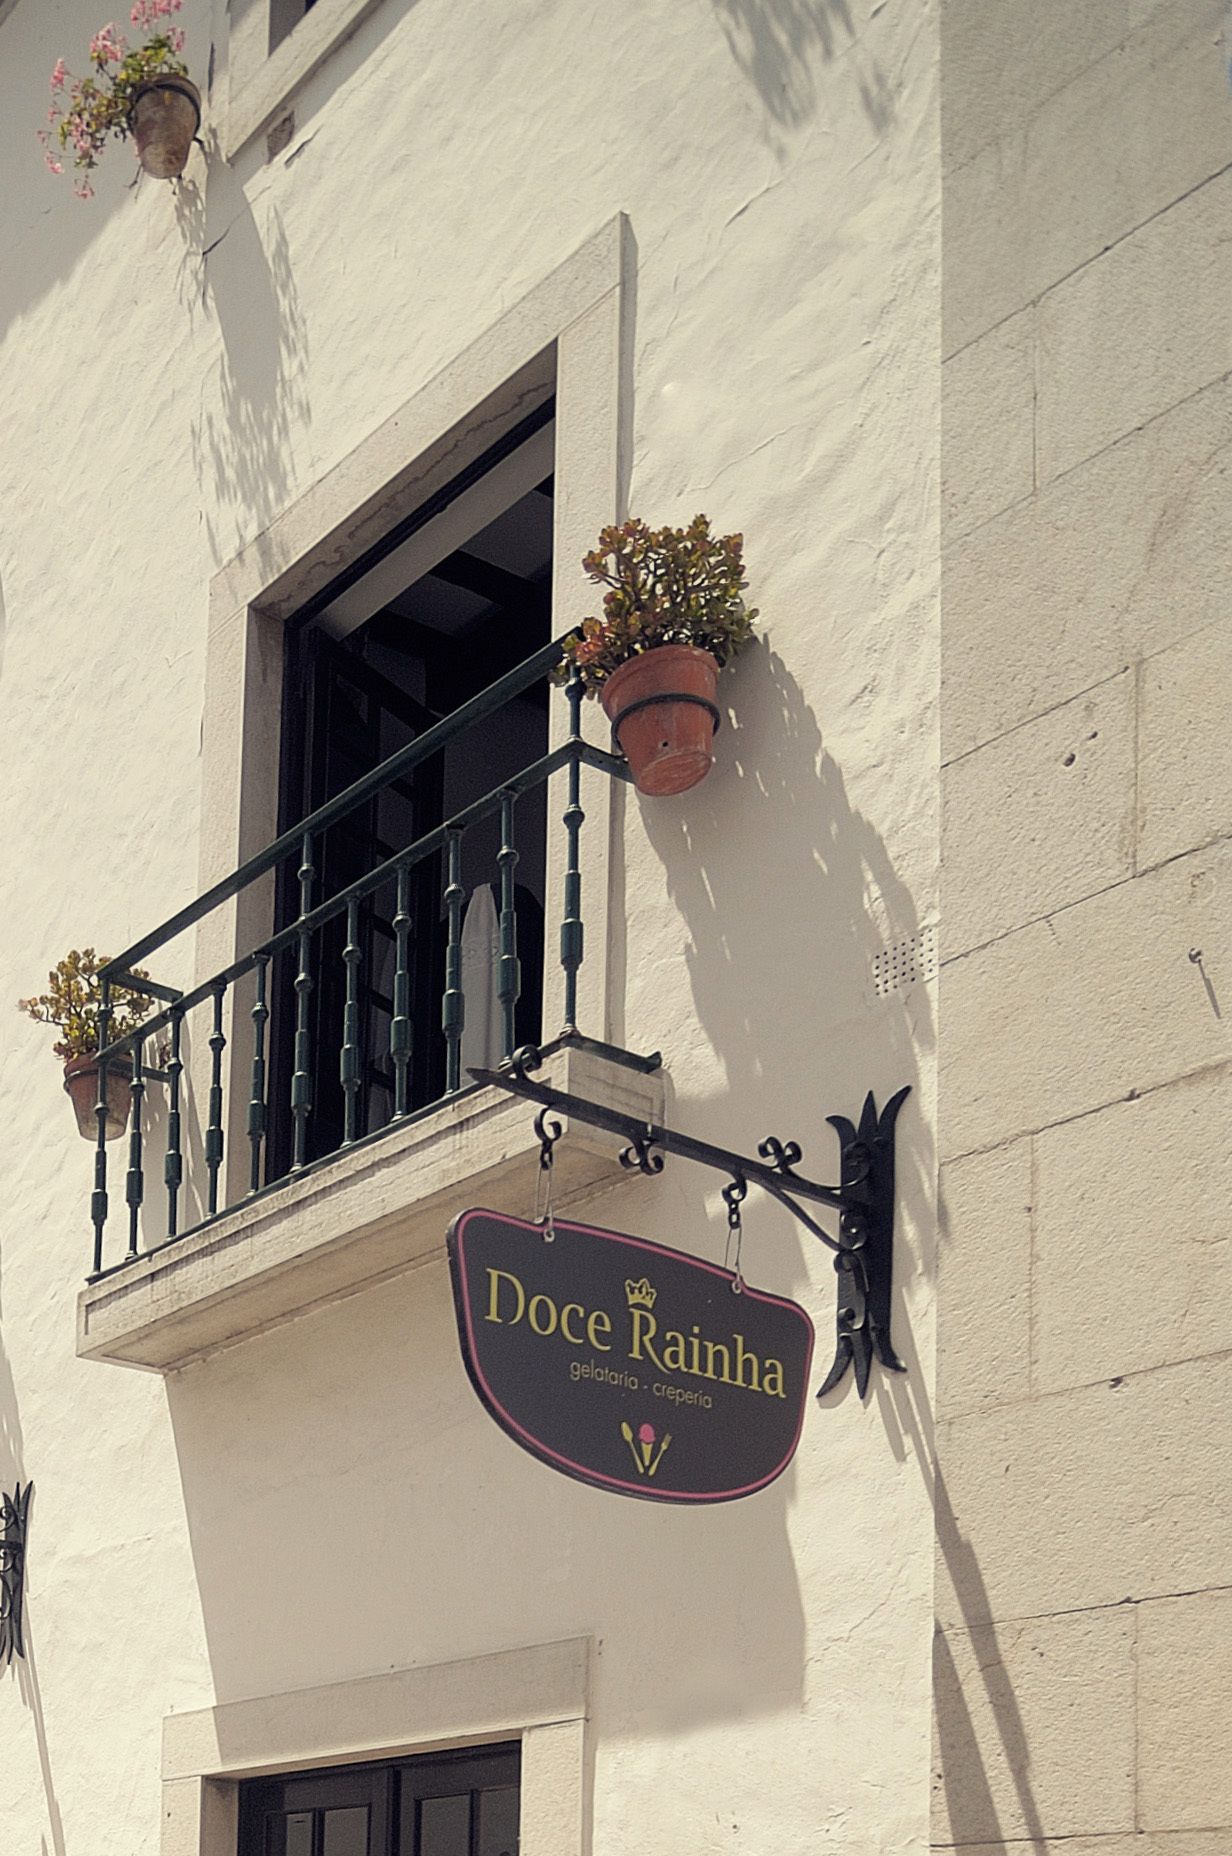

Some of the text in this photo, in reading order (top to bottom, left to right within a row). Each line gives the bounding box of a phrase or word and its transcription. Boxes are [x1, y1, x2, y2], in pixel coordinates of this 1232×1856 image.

[485, 1268, 786, 1398] Doce Rainha
[570, 1360, 638, 1390] gelataria
[653, 1382, 712, 1408] creperia
